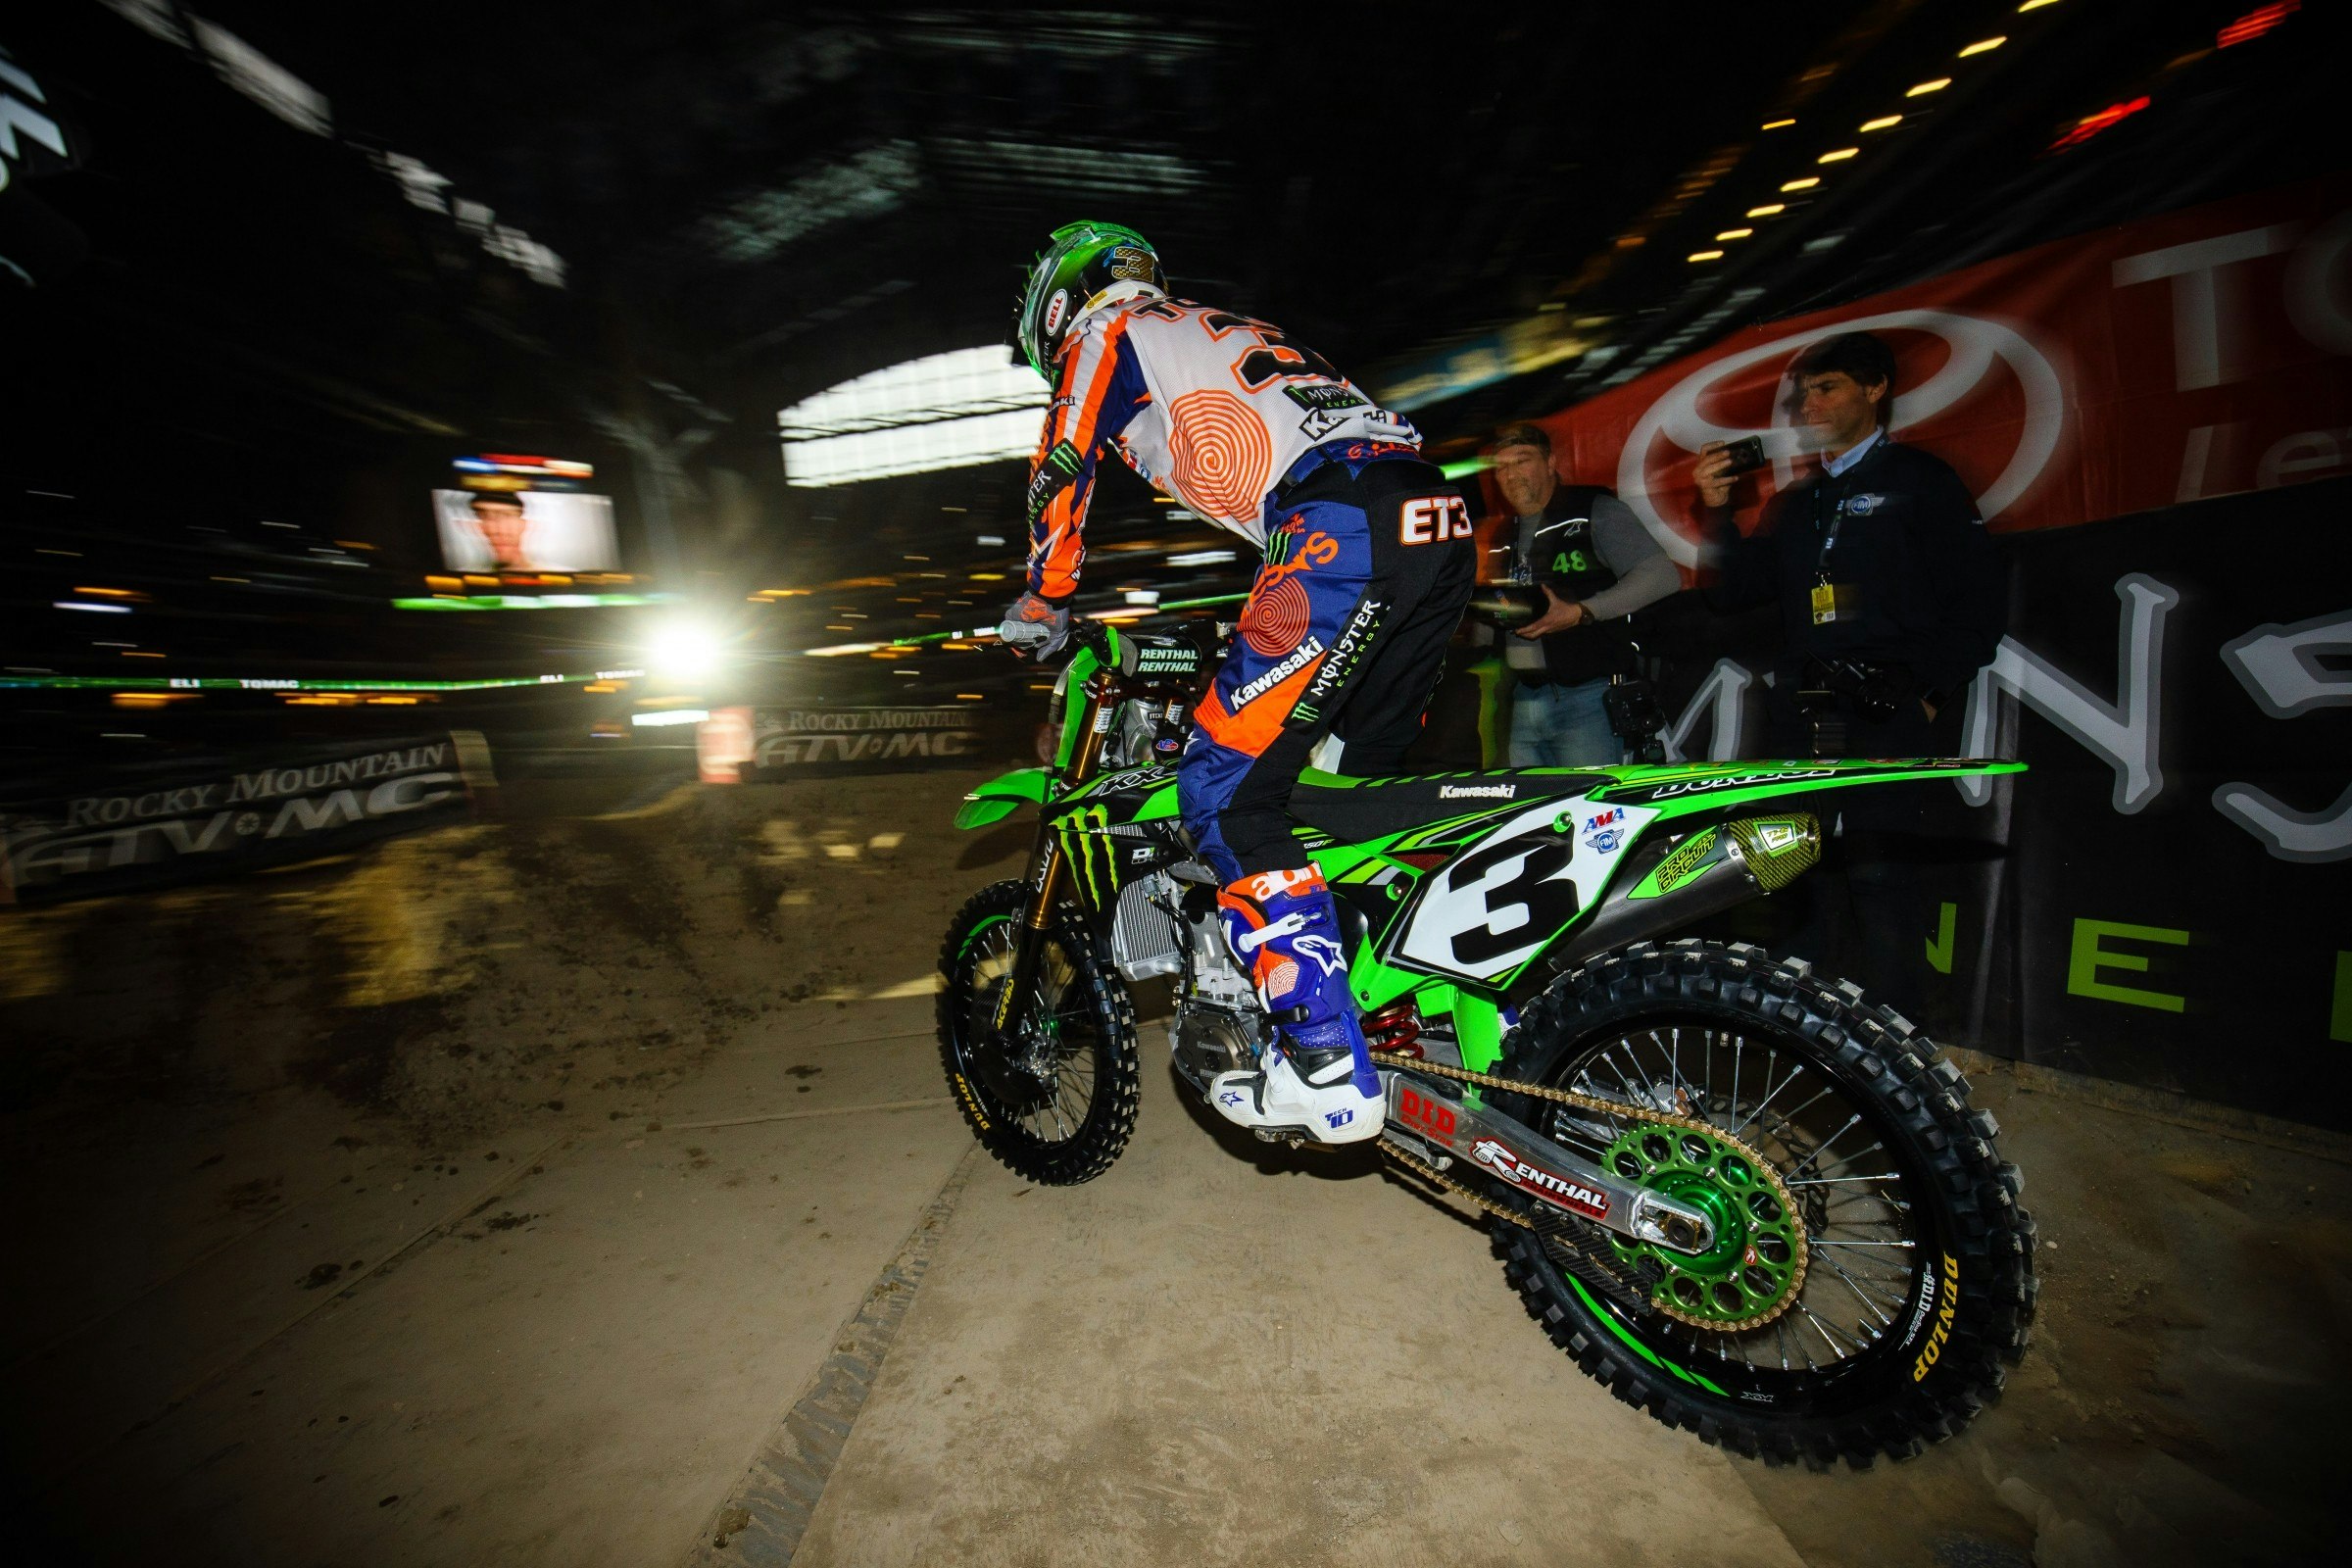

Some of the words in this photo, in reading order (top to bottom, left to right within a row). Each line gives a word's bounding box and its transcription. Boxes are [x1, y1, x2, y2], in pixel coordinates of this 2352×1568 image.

[1110, 246, 1154, 283] 3
[1047, 296, 1064, 329] BELL
[1398, 496, 1473, 546] ET3
[1552, 550, 1588, 573] 48
[1138, 662, 1197, 672] RENTHAL
[1140, 648, 1199, 660] RENTHAL
[1336, 619, 1381, 688] ENERGY
[170, 678, 201, 689] ELI
[239, 678, 300, 690] TOMAC
[1230, 635, 1324, 711] Kawasaki
[788, 710, 863, 732] ROCKY
[880, 731, 976, 760] MC
[61, 783, 218, 831] ROCKY
[224, 743, 448, 804] MOUNTAIN
[1439, 784, 1516, 799] Kawasaki
[264, 771, 464, 840] MC
[1582, 807, 1625, 833] AMA
[1656, 846, 1690, 881] PRO
[1659, 833, 1717, 892] CIRCUIT
[1447, 823, 1581, 965] 3
[1913, 1251, 1959, 1382] DUNLOP
